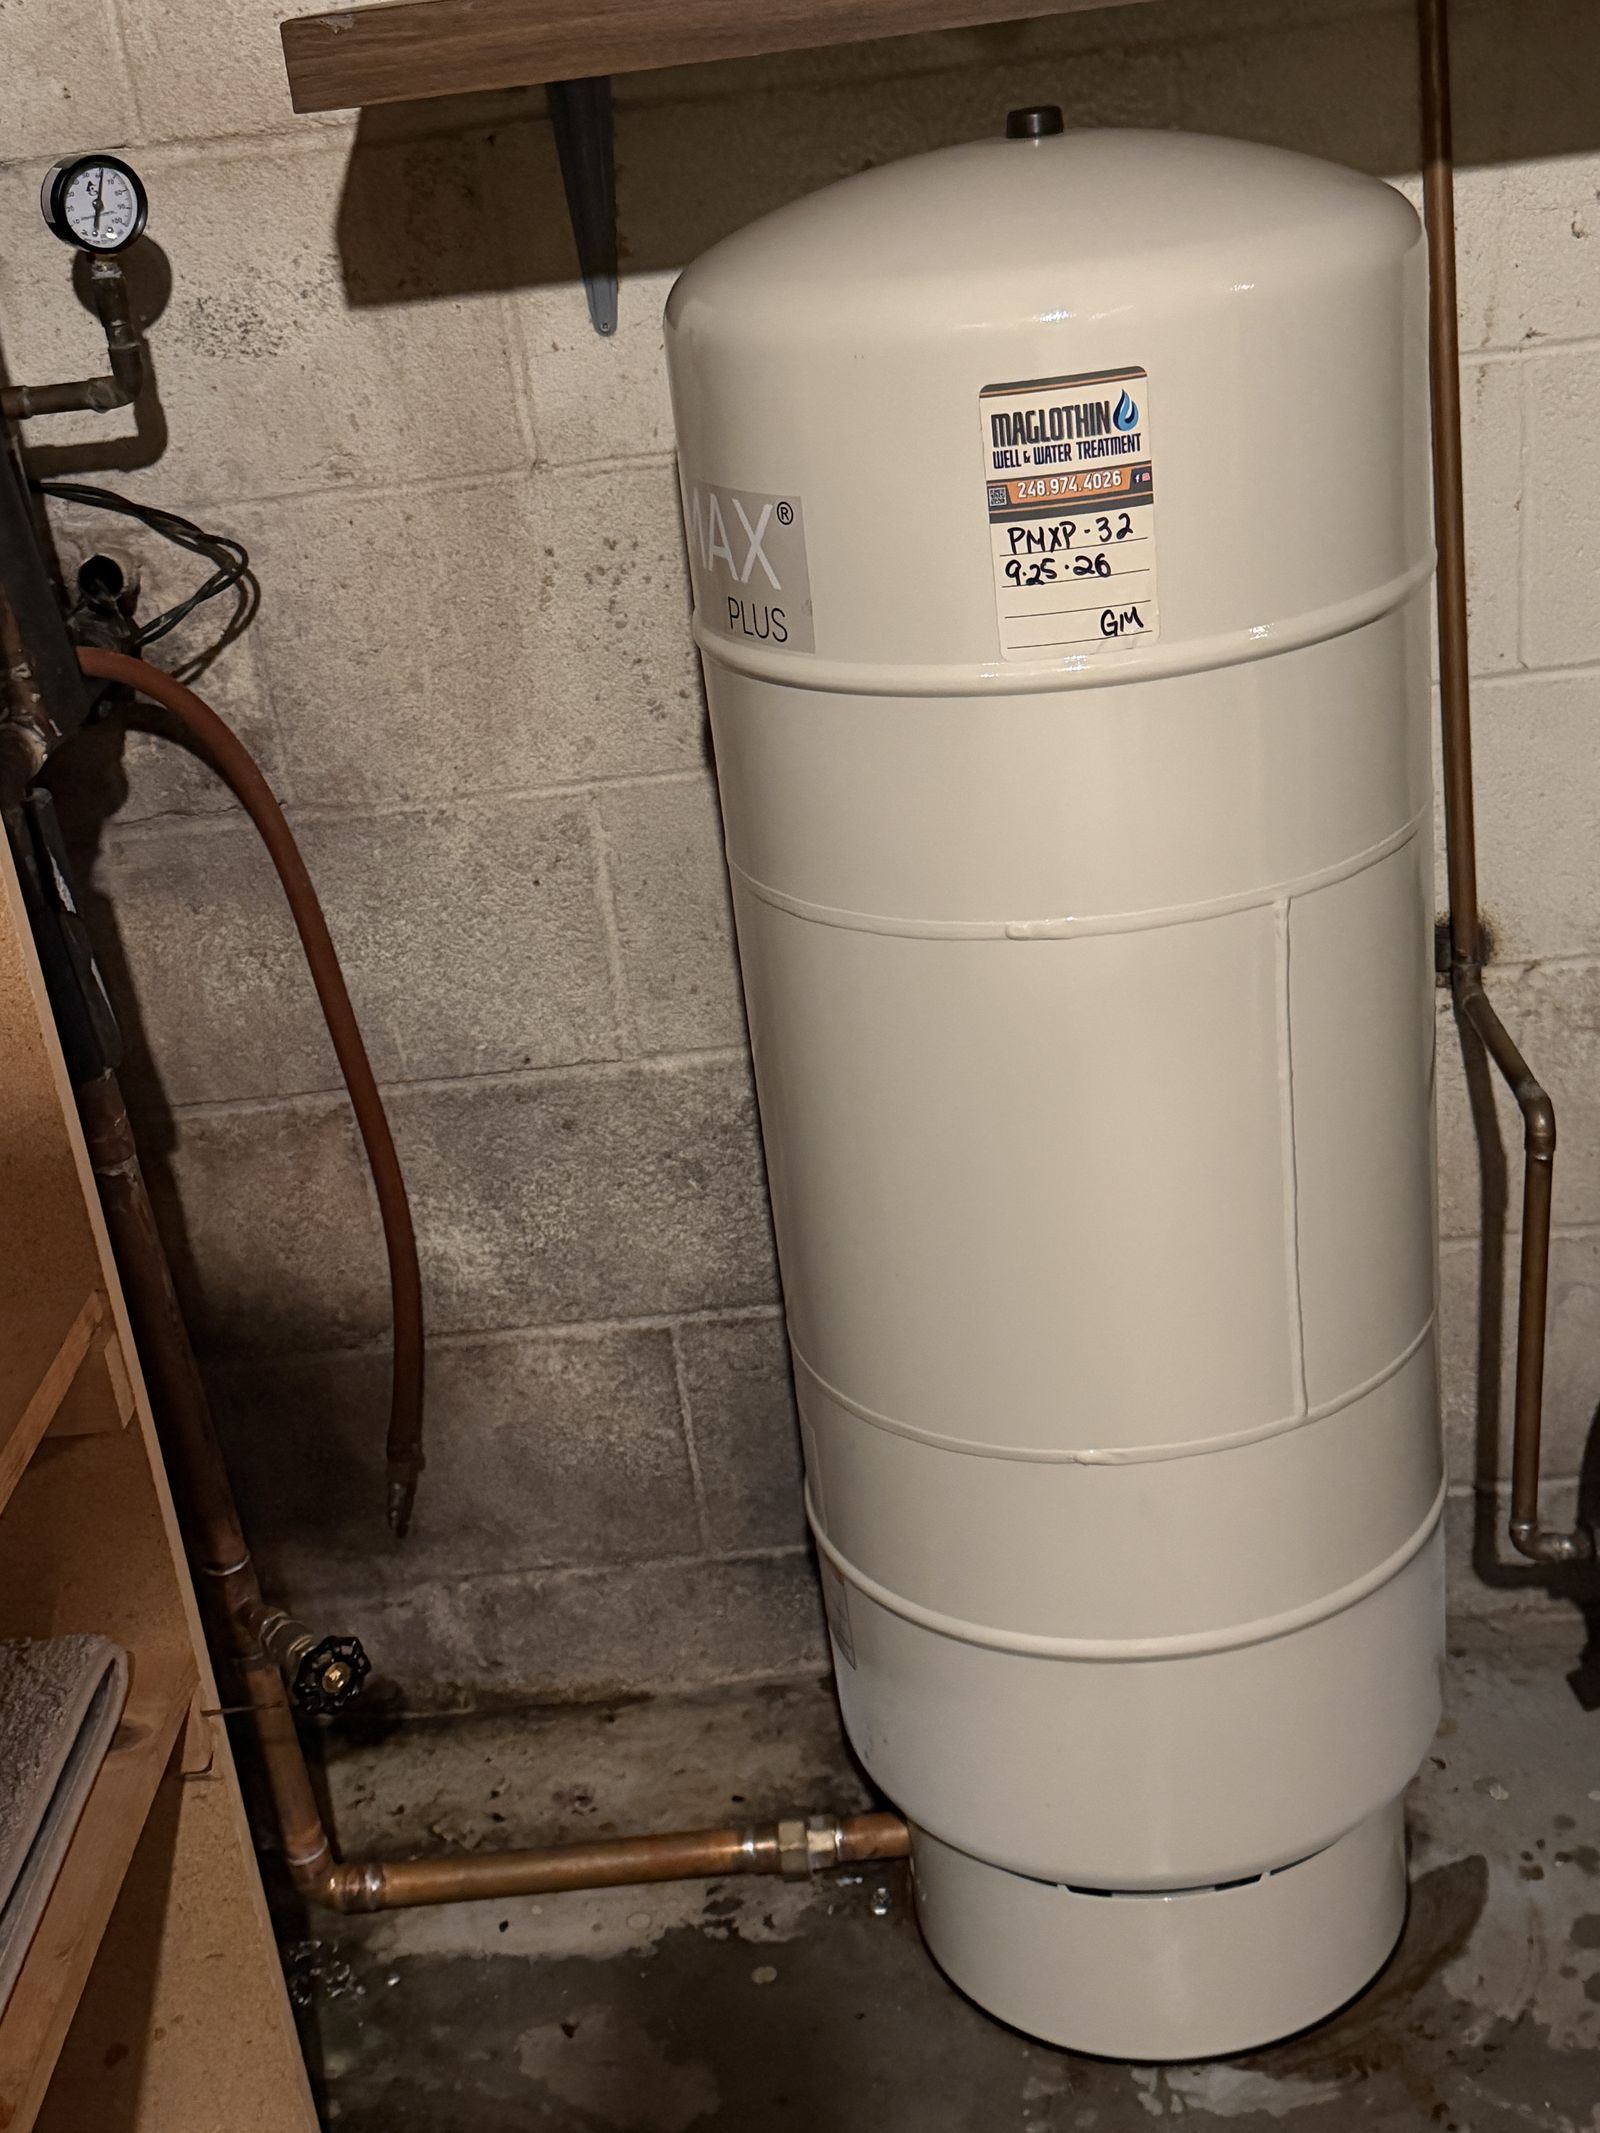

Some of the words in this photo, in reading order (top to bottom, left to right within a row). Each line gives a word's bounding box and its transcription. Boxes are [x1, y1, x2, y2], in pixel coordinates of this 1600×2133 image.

[990, 400, 1112, 448] MAGLOTHIN
[992, 449, 1022, 469] WELL
[1023, 450, 1031, 464] &
[1033, 443, 1073, 465] WATER
[1076, 432, 1142, 461] TREATMENT
[1017, 470, 1122, 499] 248.974.4026
[727, 595, 788, 643] PLUS
[1100, 606, 1144, 637] GM
